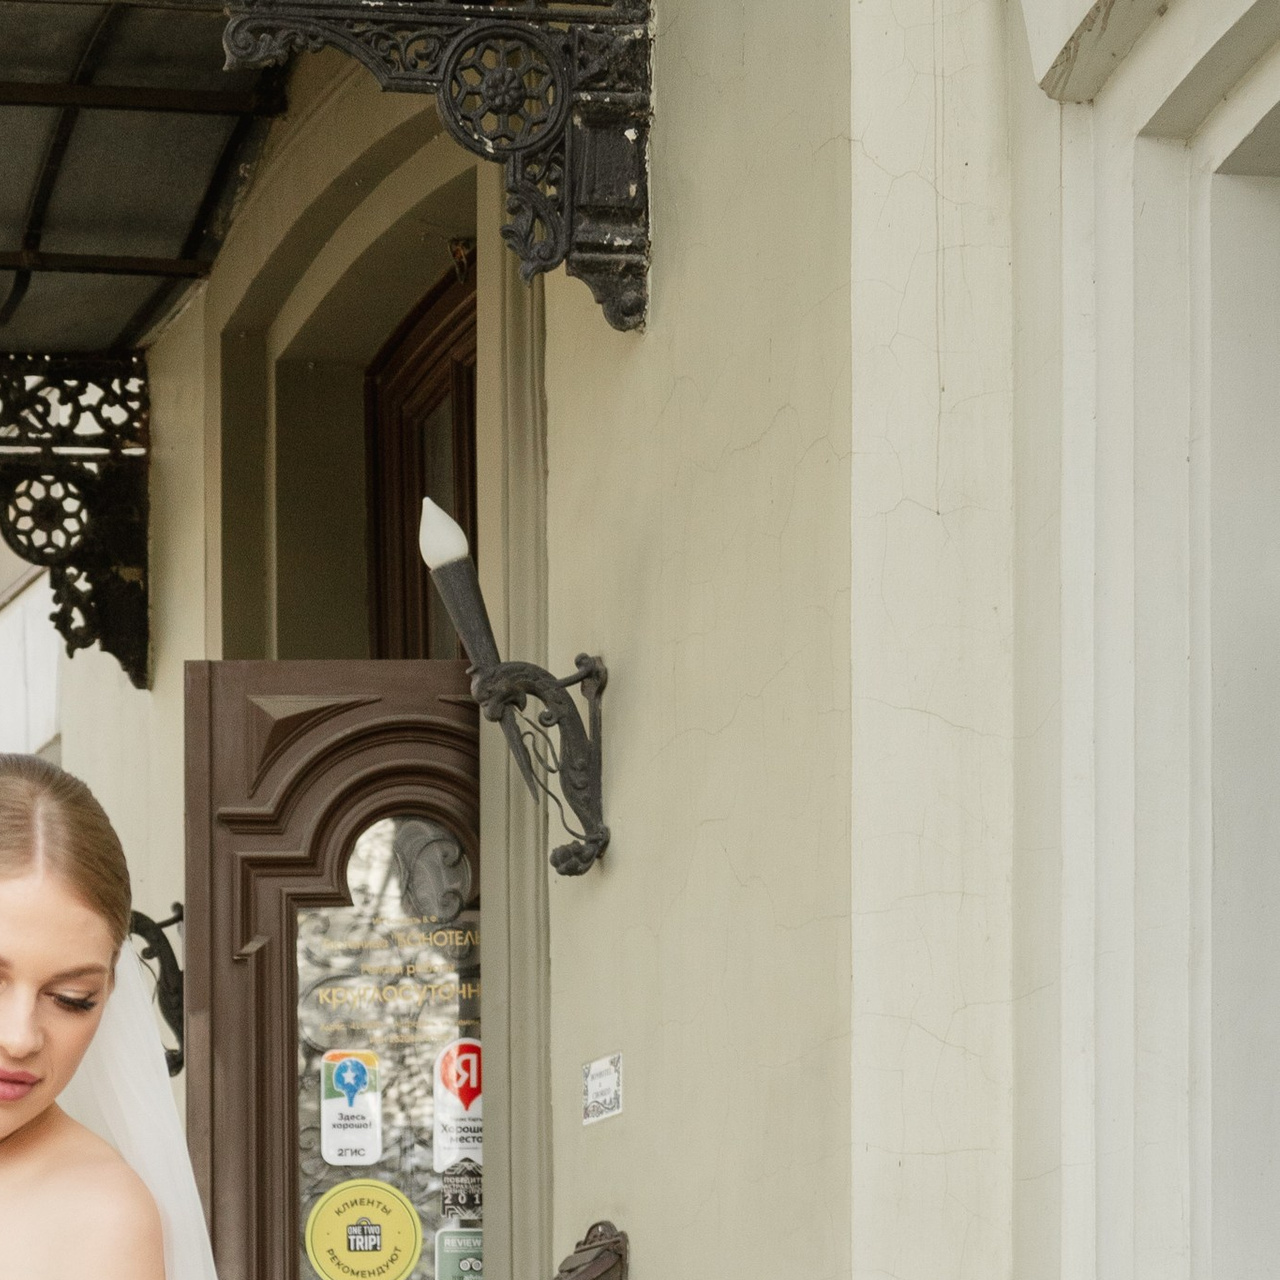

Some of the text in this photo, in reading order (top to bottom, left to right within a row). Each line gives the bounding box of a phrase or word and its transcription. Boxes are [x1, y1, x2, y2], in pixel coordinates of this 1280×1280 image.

[337, 1113, 366, 1121] Здесь
[332, 1122, 372, 1130] хорошо!
[337, 1148, 366, 1157] 2ГИС
[334, 1197, 392, 1218] КЛИЕНТЫ
[347, 1225, 381, 1235] ONE TWO
[348, 1235, 381, 1251] TRIP!
[444, 1239, 482, 1247] REVIEW
[326, 1246, 403, 1279] РЕКОМЕНДУЮТ
